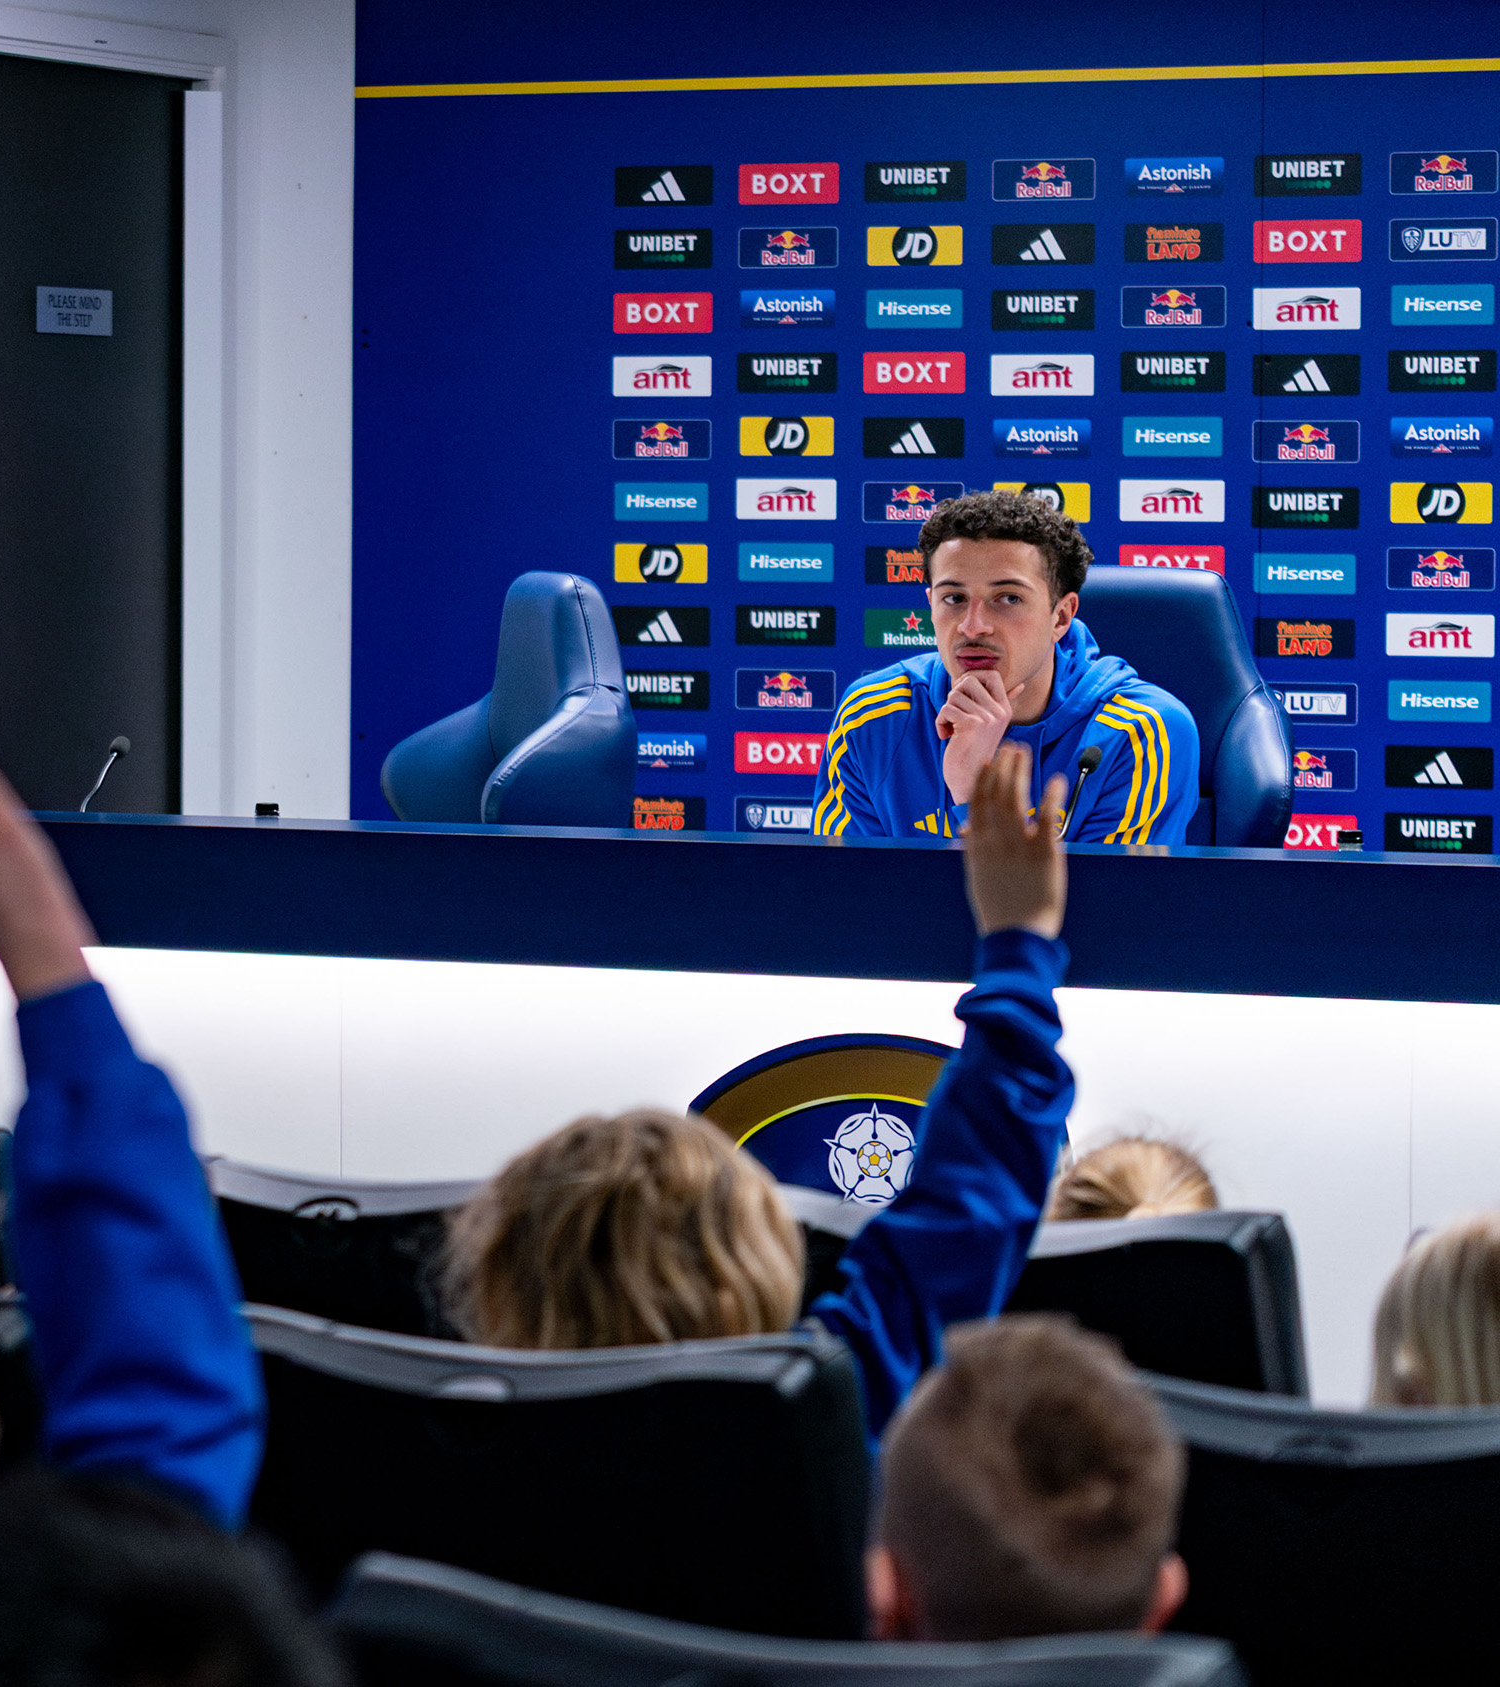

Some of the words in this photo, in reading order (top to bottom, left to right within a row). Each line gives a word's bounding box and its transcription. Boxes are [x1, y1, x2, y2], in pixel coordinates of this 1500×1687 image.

[880, 167, 950, 185] UNIBET
[1138, 164, 1211, 181] Astonish
[1271, 161, 1345, 179] UNIBET
[752, 172, 825, 195] BOXT
[1016, 182, 1044, 197] Red
[1045, 181, 1071, 197] Bull
[1415, 175, 1443, 191] Red
[1444, 174, 1473, 191] Bull
[629, 235, 698, 252] UNIBET
[896, 232, 933, 259] JD
[1268, 230, 1347, 252] BOXT
[1429, 231, 1482, 248] LUTV
[762, 250, 788, 266] Red
[788, 250, 815, 266] Bull
[1147, 243, 1201, 261] LAND
[48, 294, 77, 309] PLEASE
[80, 296, 102, 310] MIND
[753, 296, 823, 313] Astonish
[878, 301, 952, 316] Hisense
[1007, 296, 1079, 313] UNIBET
[1276, 299, 1339, 323] amt
[1404, 297, 1482, 312] Hisense
[57, 313, 71, 326] THE
[74, 314, 93, 327] STEP
[626, 302, 699, 324] BOXT
[1146, 308, 1173, 325] Red
[1174, 308, 1202, 325] Bull
[752, 358, 822, 376] UNIBET
[876, 361, 951, 384] BOXT
[1136, 357, 1209, 375] UNIBET
[1405, 356, 1480, 374] UNIBET
[633, 367, 692, 389] amt
[1012, 366, 1073, 389] amt
[769, 423, 805, 450] JD
[1006, 426, 1078, 443] Astonish
[1135, 429, 1211, 444] Hisense
[1404, 424, 1480, 441] Astonish
[635, 441, 661, 457] Red
[662, 441, 688, 457] Bull
[1278, 443, 1305, 460] Red
[1307, 443, 1335, 460] Bull
[626, 494, 697, 509] Hisense
[757, 490, 816, 512] amt
[1141, 492, 1203, 514] amt
[1269, 493, 1343, 511] UNIBET
[1422, 489, 1461, 516] JD
[886, 505, 913, 520] Red
[914, 505, 937, 519] Bul
[643, 550, 679, 576] JD
[750, 555, 823, 569] Hisense
[887, 565, 924, 583] LAN
[1267, 565, 1344, 581] Hisense
[1412, 571, 1440, 588] Red
[1441, 571, 1470, 588] Bull
[750, 611, 821, 629] UNIBET
[1408, 626, 1472, 649] amt
[1278, 638, 1333, 656] LAND
[626, 674, 694, 693] UNIBET
[758, 690, 783, 707] Red
[785, 691, 812, 708] Bull
[1401, 693, 1479, 709] Hisense
[638, 739, 694, 757] stonish
[747, 741, 822, 765] BOXT
[1305, 771, 1332, 788] Bull
[634, 813, 685, 831] LAND
[1400, 820, 1476, 839] UNIBET
[1284, 823, 1342, 847] OXT
